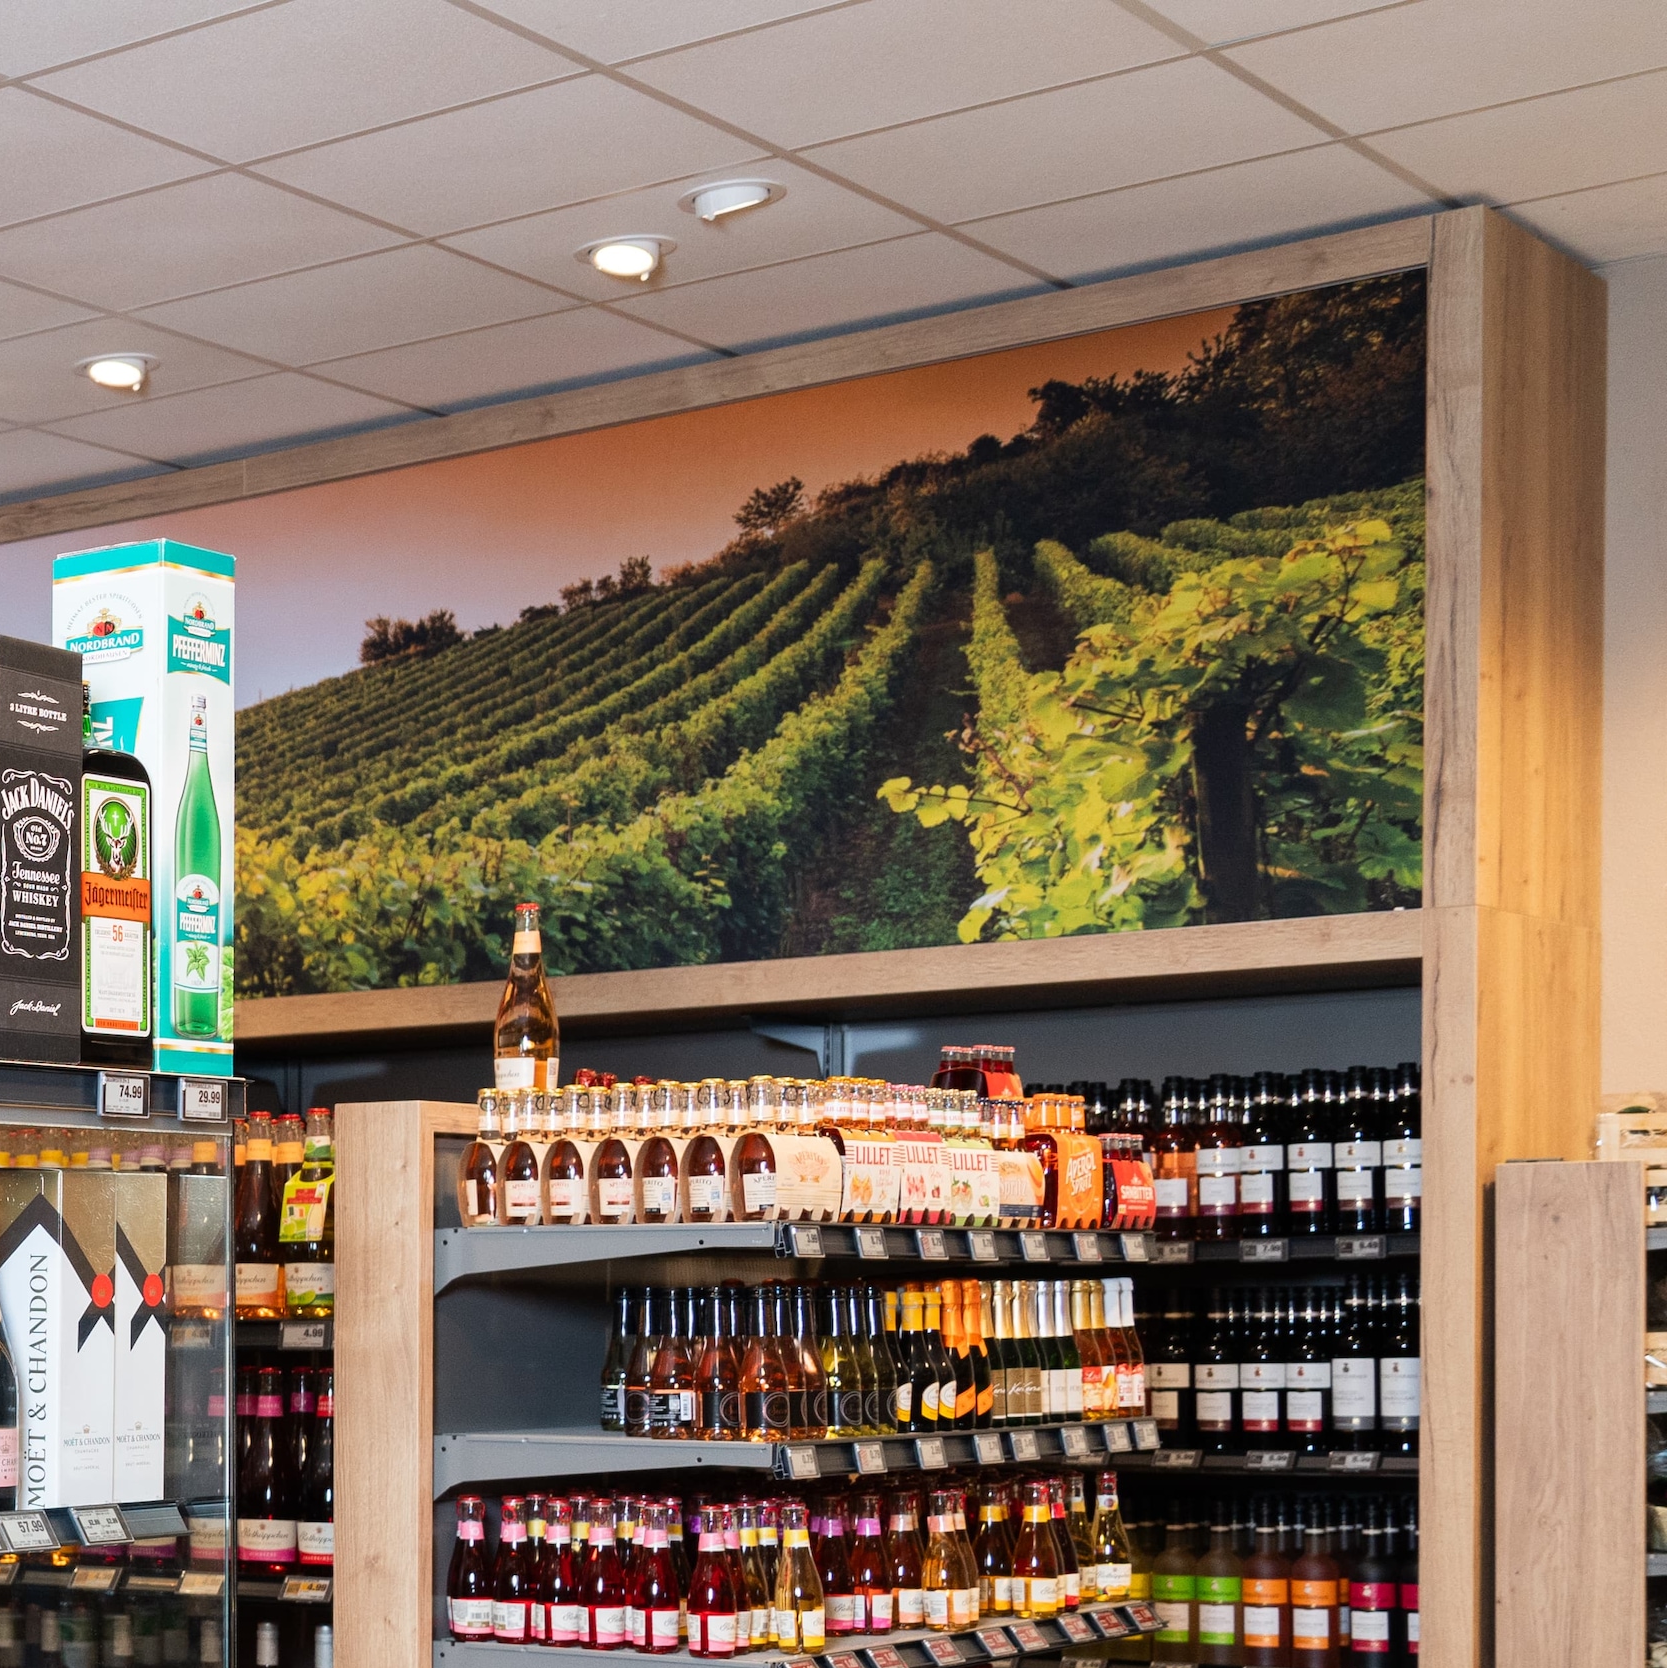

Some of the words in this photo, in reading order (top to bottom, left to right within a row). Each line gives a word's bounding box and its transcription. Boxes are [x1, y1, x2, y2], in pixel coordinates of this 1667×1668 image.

[70, 632, 140, 652] NORDBRAND
[173, 634, 225, 667] PFEFFERMINZ
[10, 703, 14, 711] 3
[17, 705, 37, 717] LITRE
[40, 708, 66, 721] BOTTLE
[2, 783, 28, 820] JACK
[11, 861, 60, 885] Tennessee
[12, 891, 59, 908] WHISKEY
[112, 925, 123, 942] 56
[119, 1086, 141, 1098] 74.99
[199, 1091, 220, 1104] 29.99
[856, 1145, 890, 1165] LILLET
[906, 1145, 938, 1164] LILLET
[954, 1153, 988, 1172] LILLET
[28, 1254, 48, 1394] CHANDON
[28, 1401, 47, 1421] &
[24, 1433, 46, 1509] MOËT
[18, 1520, 44, 1533] 57.99
